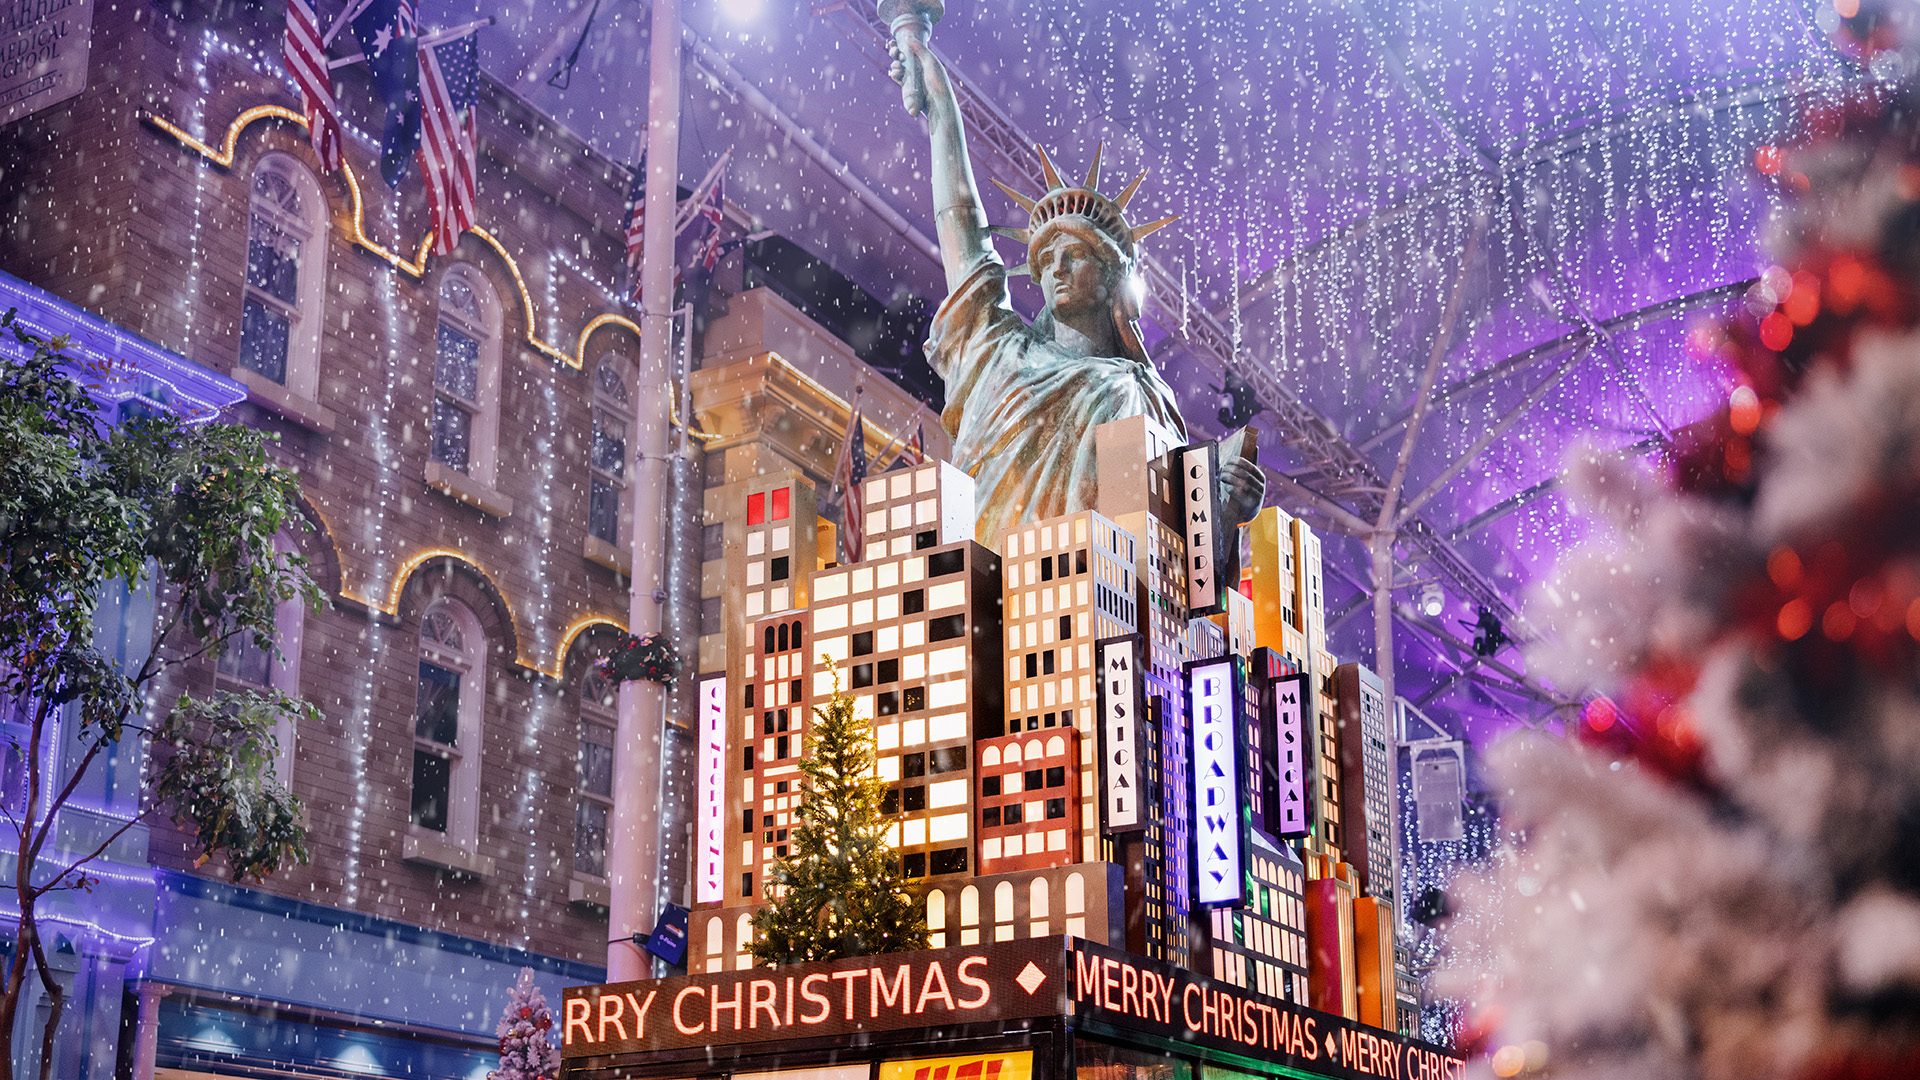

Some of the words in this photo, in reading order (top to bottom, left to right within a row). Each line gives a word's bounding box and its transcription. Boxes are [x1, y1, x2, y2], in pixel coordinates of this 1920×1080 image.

[0, 42, 60, 78] CHOOL
[1190, 464, 1209, 592] COMEDY
[1109, 656, 1130, 813] MUSICAL
[1203, 676, 1230, 890] BROADWAY
[1280, 691, 1299, 822] MUSICAL
[565, 990, 657, 1045] RRY
[672, 956, 991, 1036] CHRISTMAS
[1076, 950, 1175, 1024] MERRY
[1183, 982, 1318, 1060] CHRISTMAS
[1341, 1027, 1402, 1080] MERRY
[1406, 1045, 1467, 1080] CHRIST
